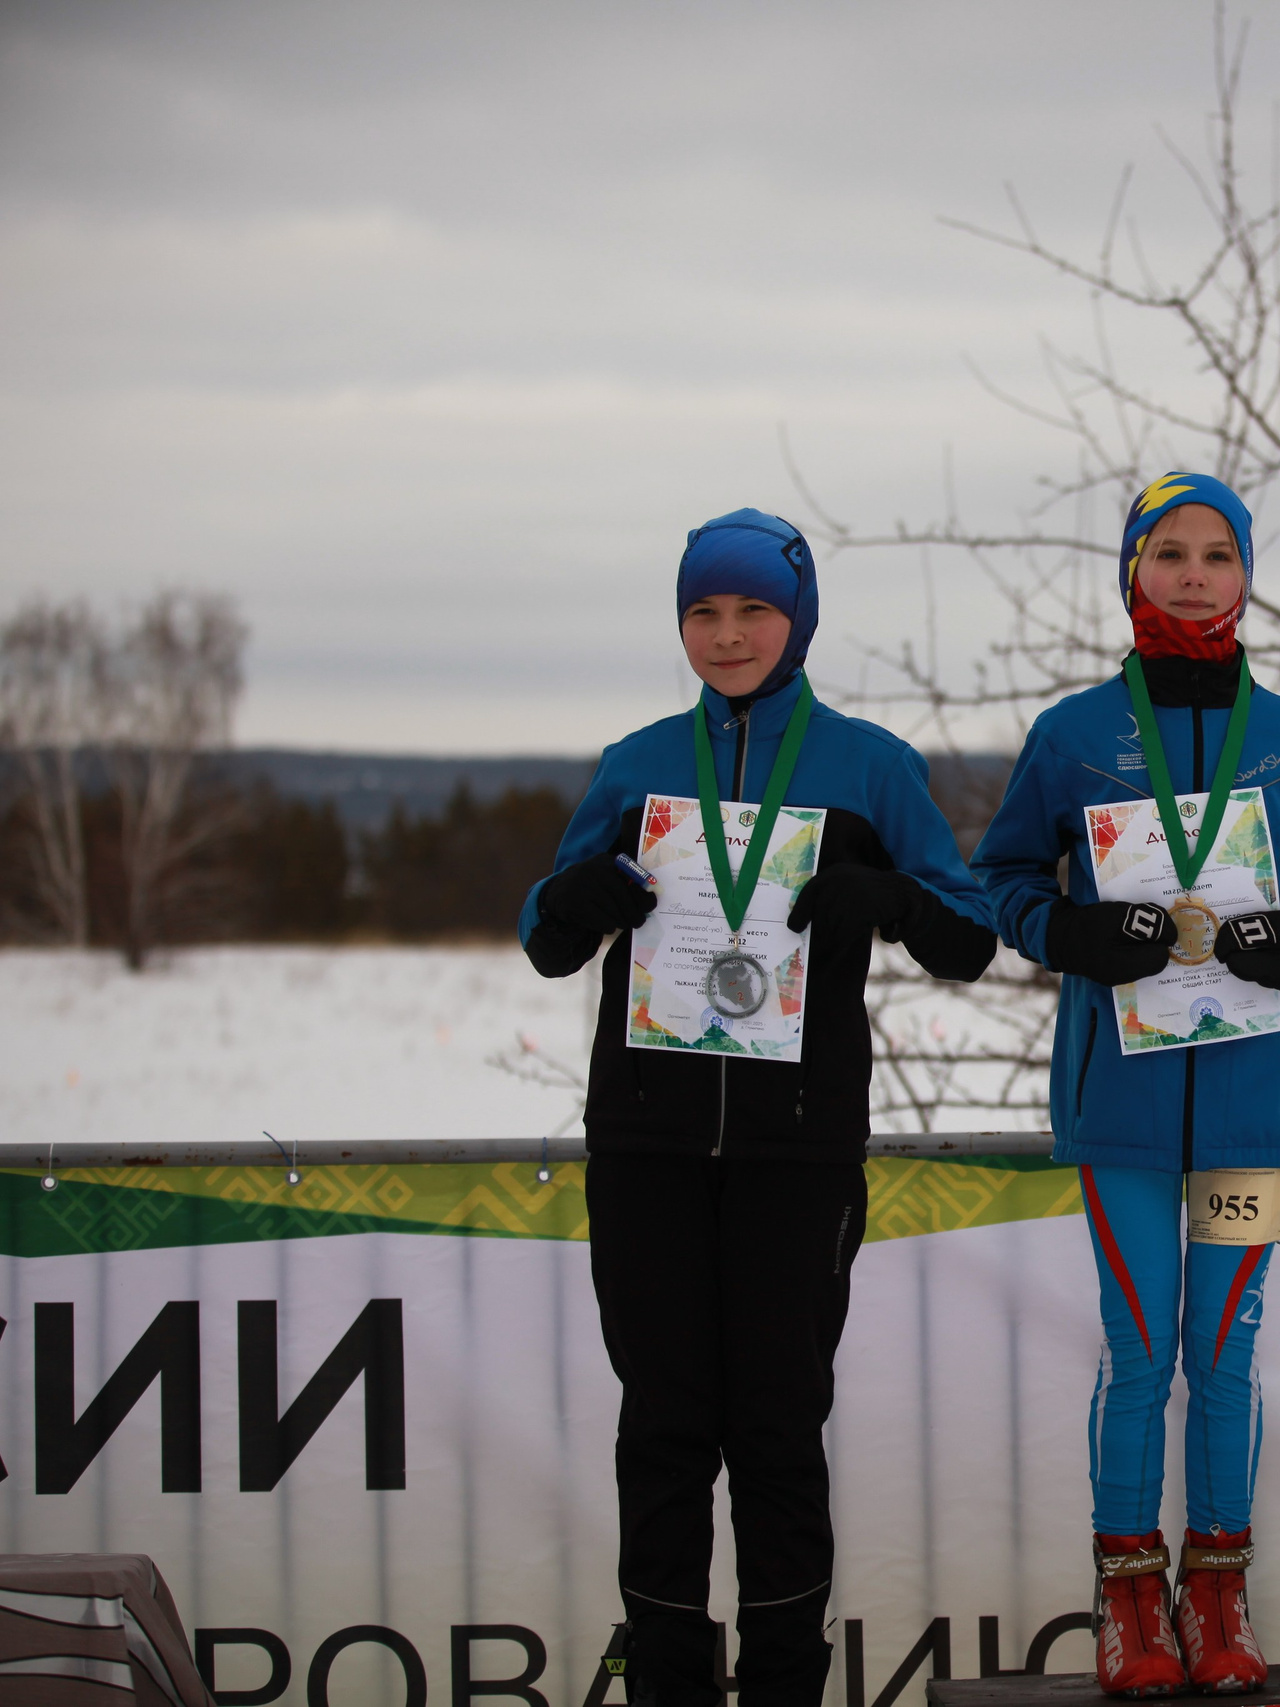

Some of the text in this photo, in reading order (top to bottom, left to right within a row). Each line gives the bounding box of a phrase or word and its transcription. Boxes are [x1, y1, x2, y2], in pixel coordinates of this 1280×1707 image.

[1208, 1193, 1259, 1221] 955
[0, 1298, 406, 1495] ИИ
[1125, 1555, 1163, 1569] alpina
[1201, 1555, 1243, 1565] alpina
